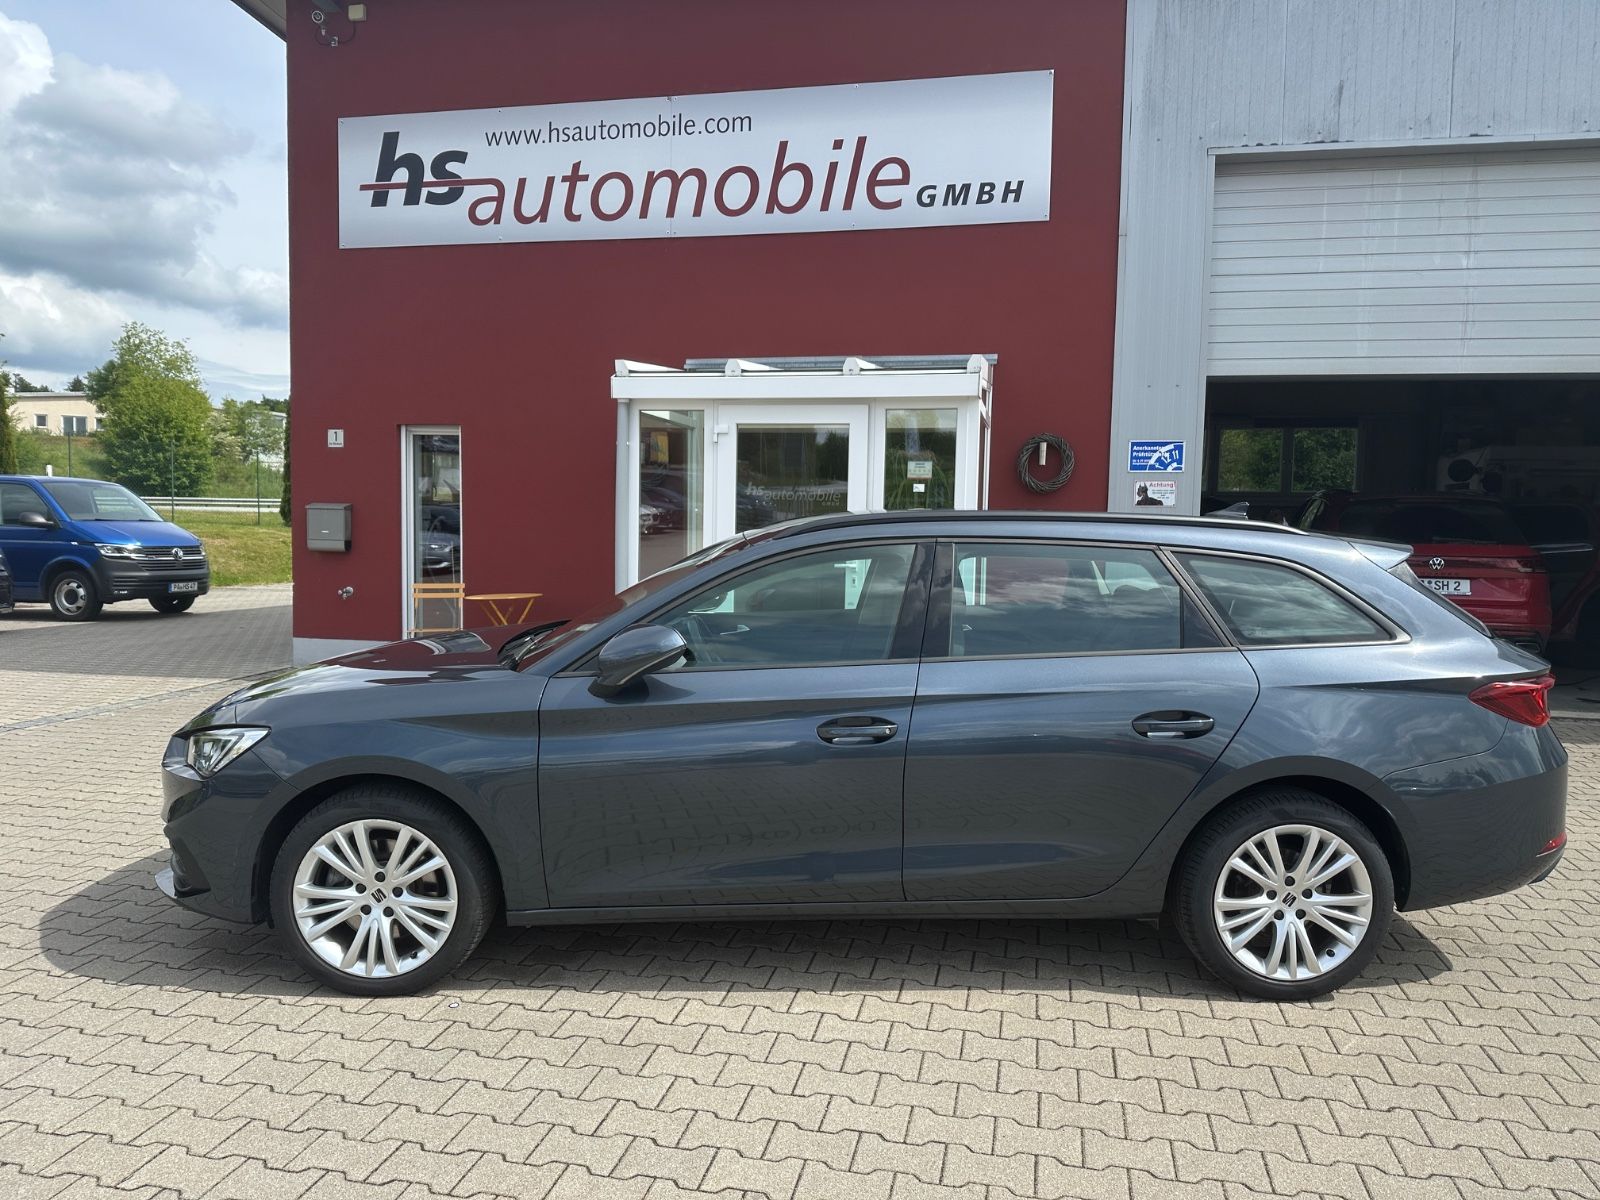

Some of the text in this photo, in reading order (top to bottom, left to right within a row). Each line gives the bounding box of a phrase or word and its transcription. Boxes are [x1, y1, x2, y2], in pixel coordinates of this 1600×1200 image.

[485, 114, 752, 146] www.hsautomobile.com
[370, 131, 1025, 226] hs automobile GMBH
[334, 431, 338, 442] 1
